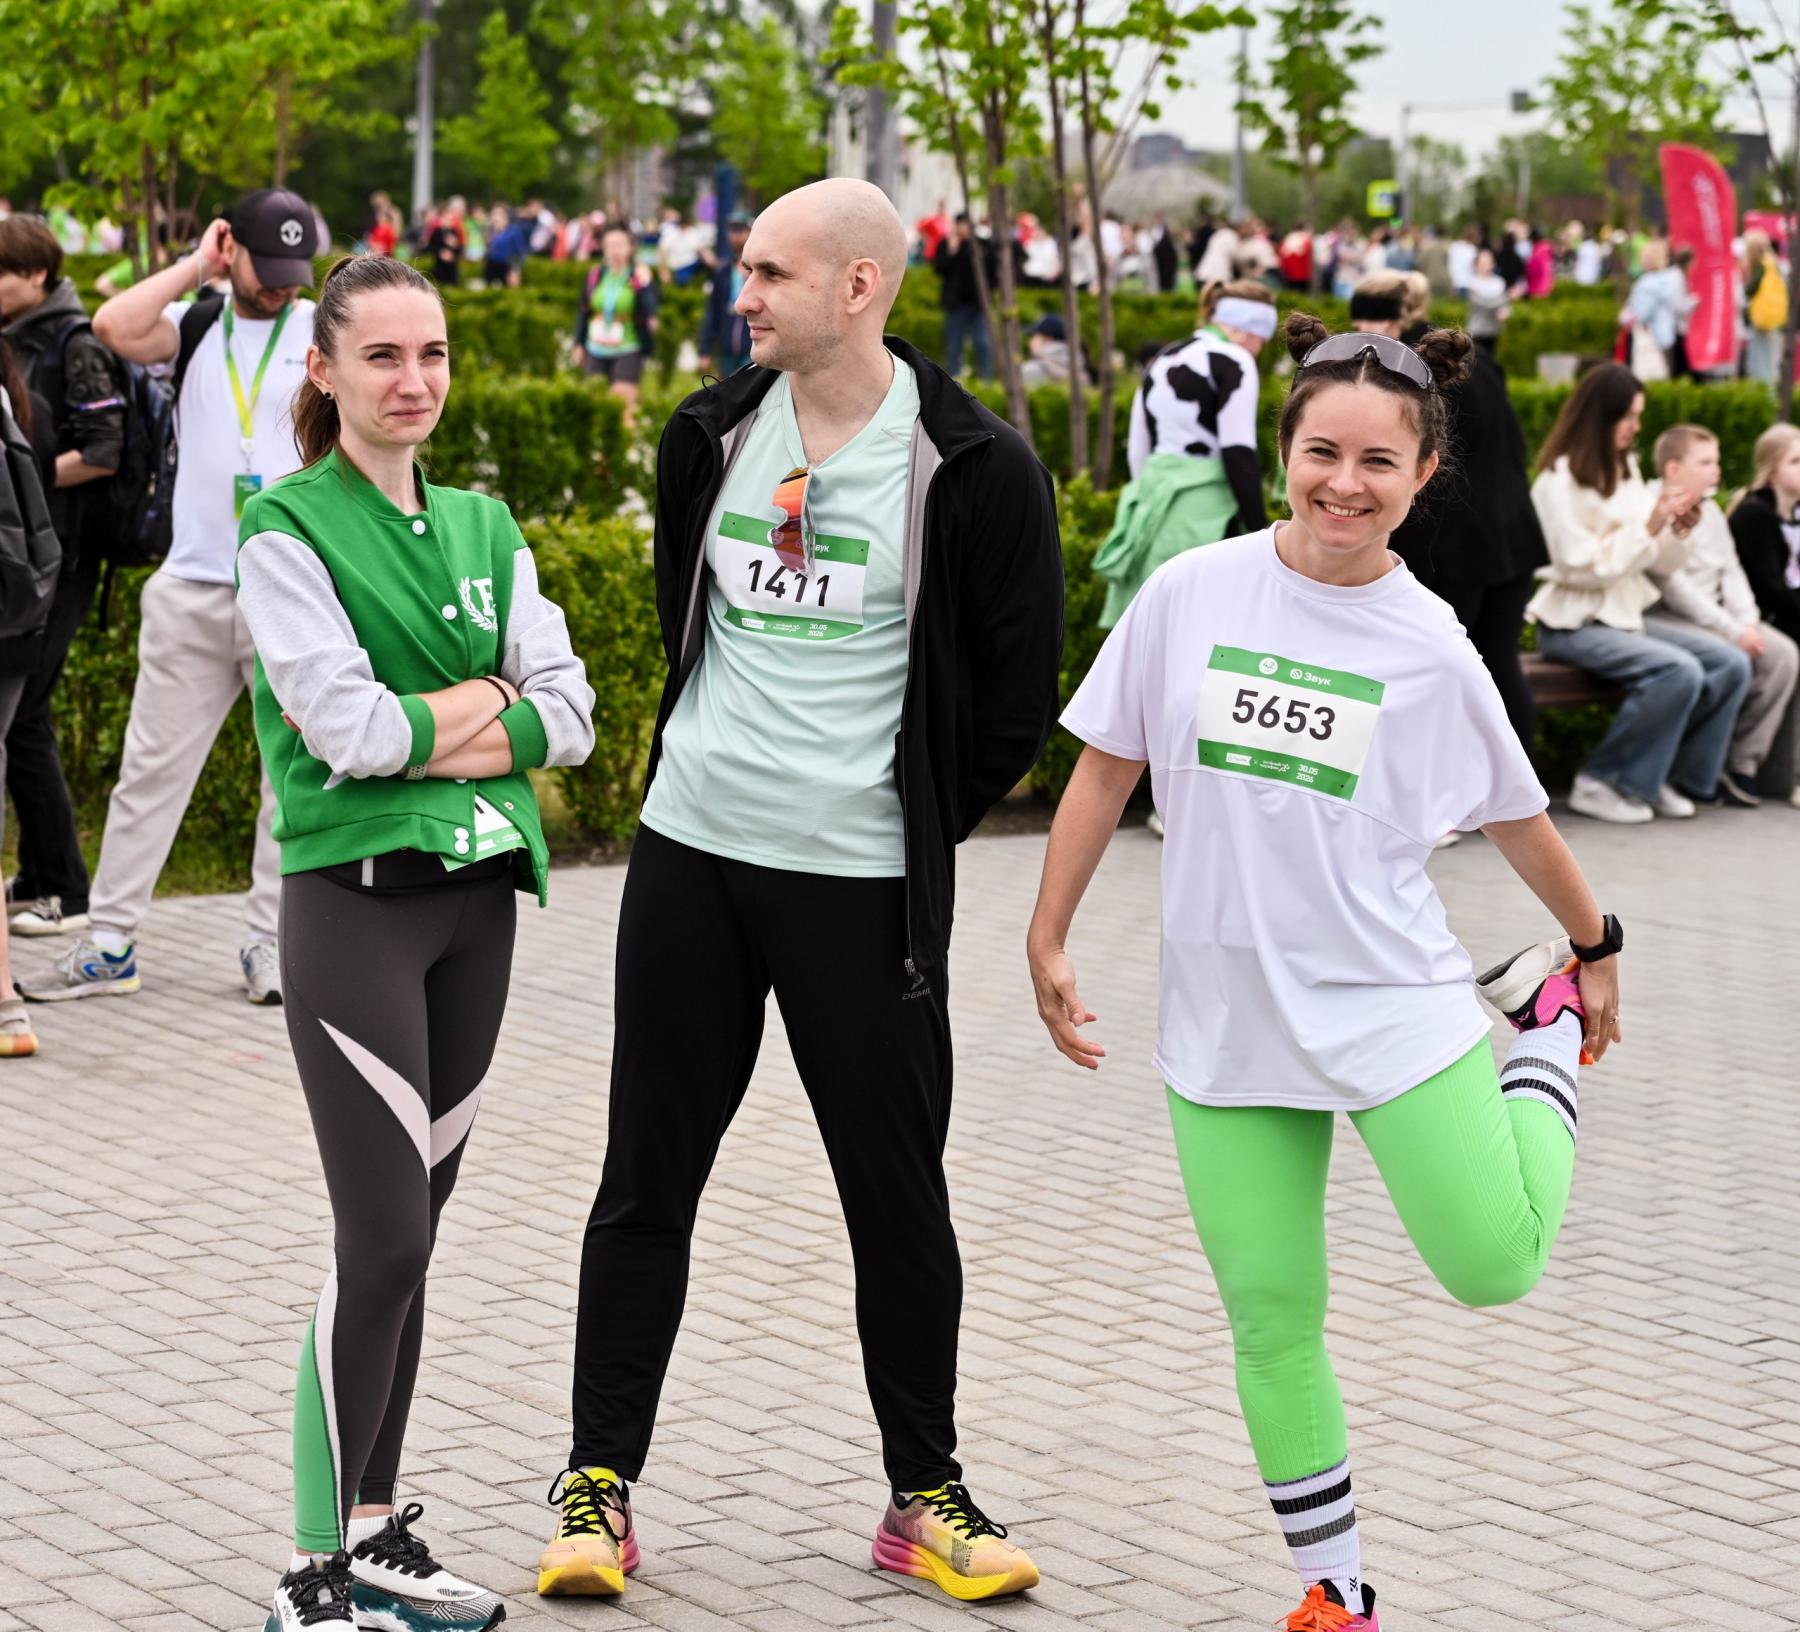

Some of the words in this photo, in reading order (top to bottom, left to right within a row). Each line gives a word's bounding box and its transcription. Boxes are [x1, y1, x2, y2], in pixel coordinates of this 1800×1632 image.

[815, 544, 830, 553] вук
[748, 559, 830, 607] 1411
[1303, 672, 1332, 686] Звук
[1232, 688, 1336, 741] 5653
[1298, 764, 1319, 776] 30.05
